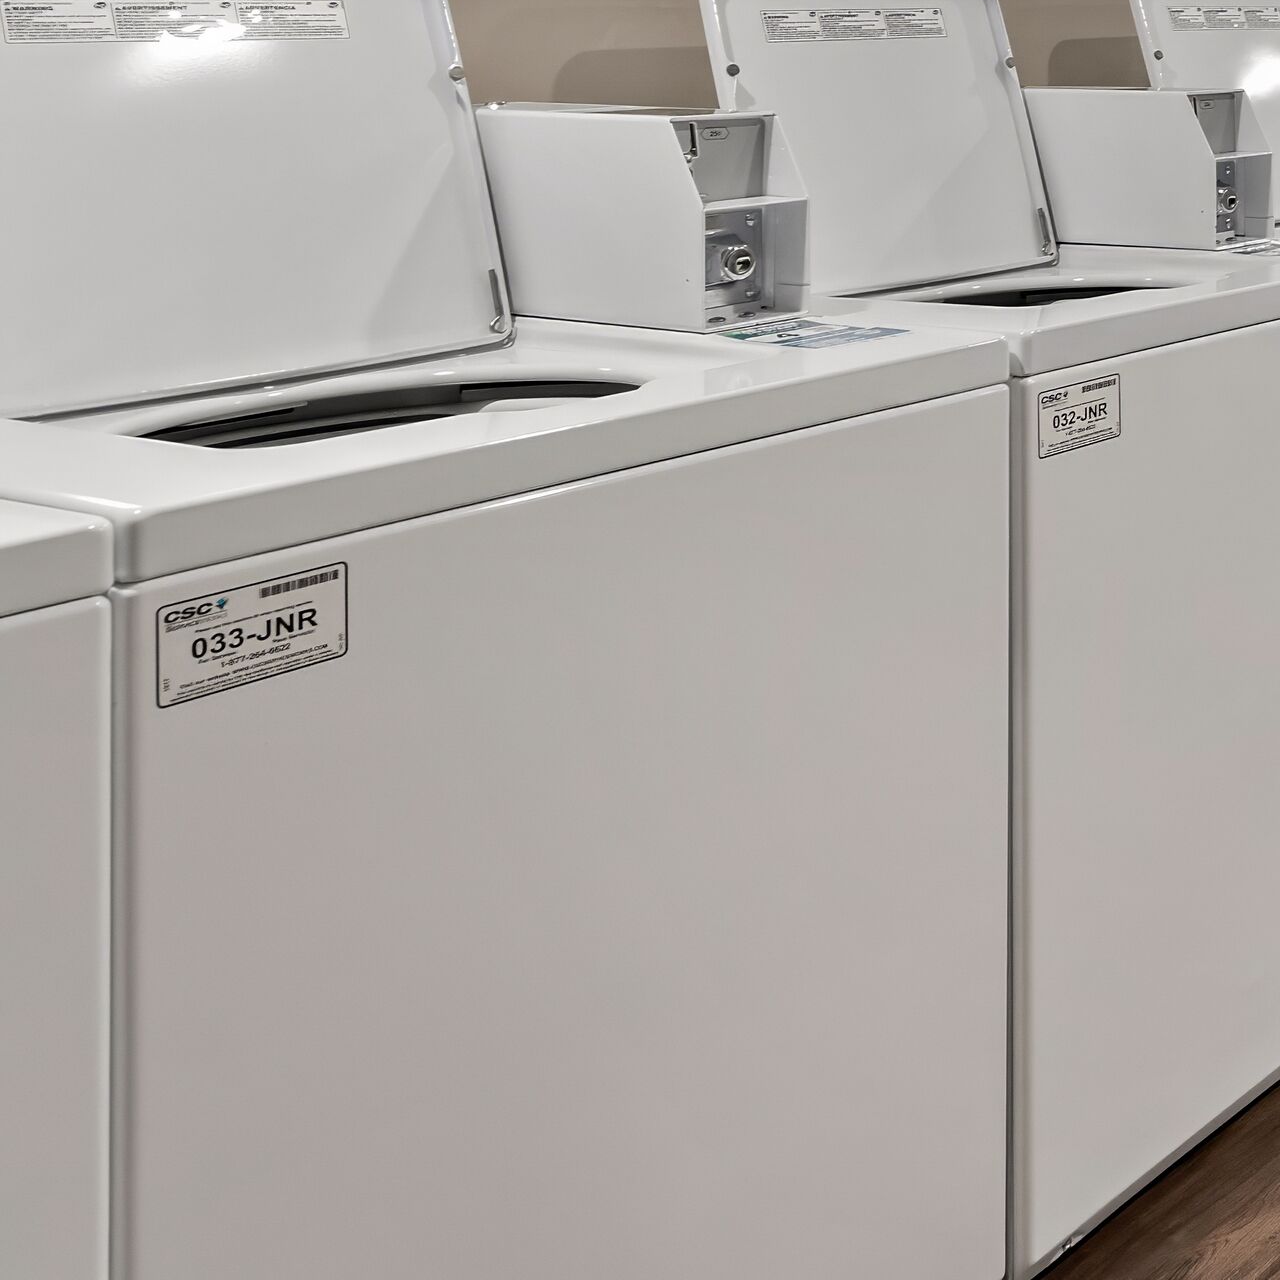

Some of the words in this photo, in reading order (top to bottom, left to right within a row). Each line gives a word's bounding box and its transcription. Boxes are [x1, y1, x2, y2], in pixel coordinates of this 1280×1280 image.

[1041, 393, 1062, 404] CSC
[1053, 403, 1107, 428] 032-JNR
[164, 602, 214, 623] CSC
[191, 608, 318, 659] 033-JNR
